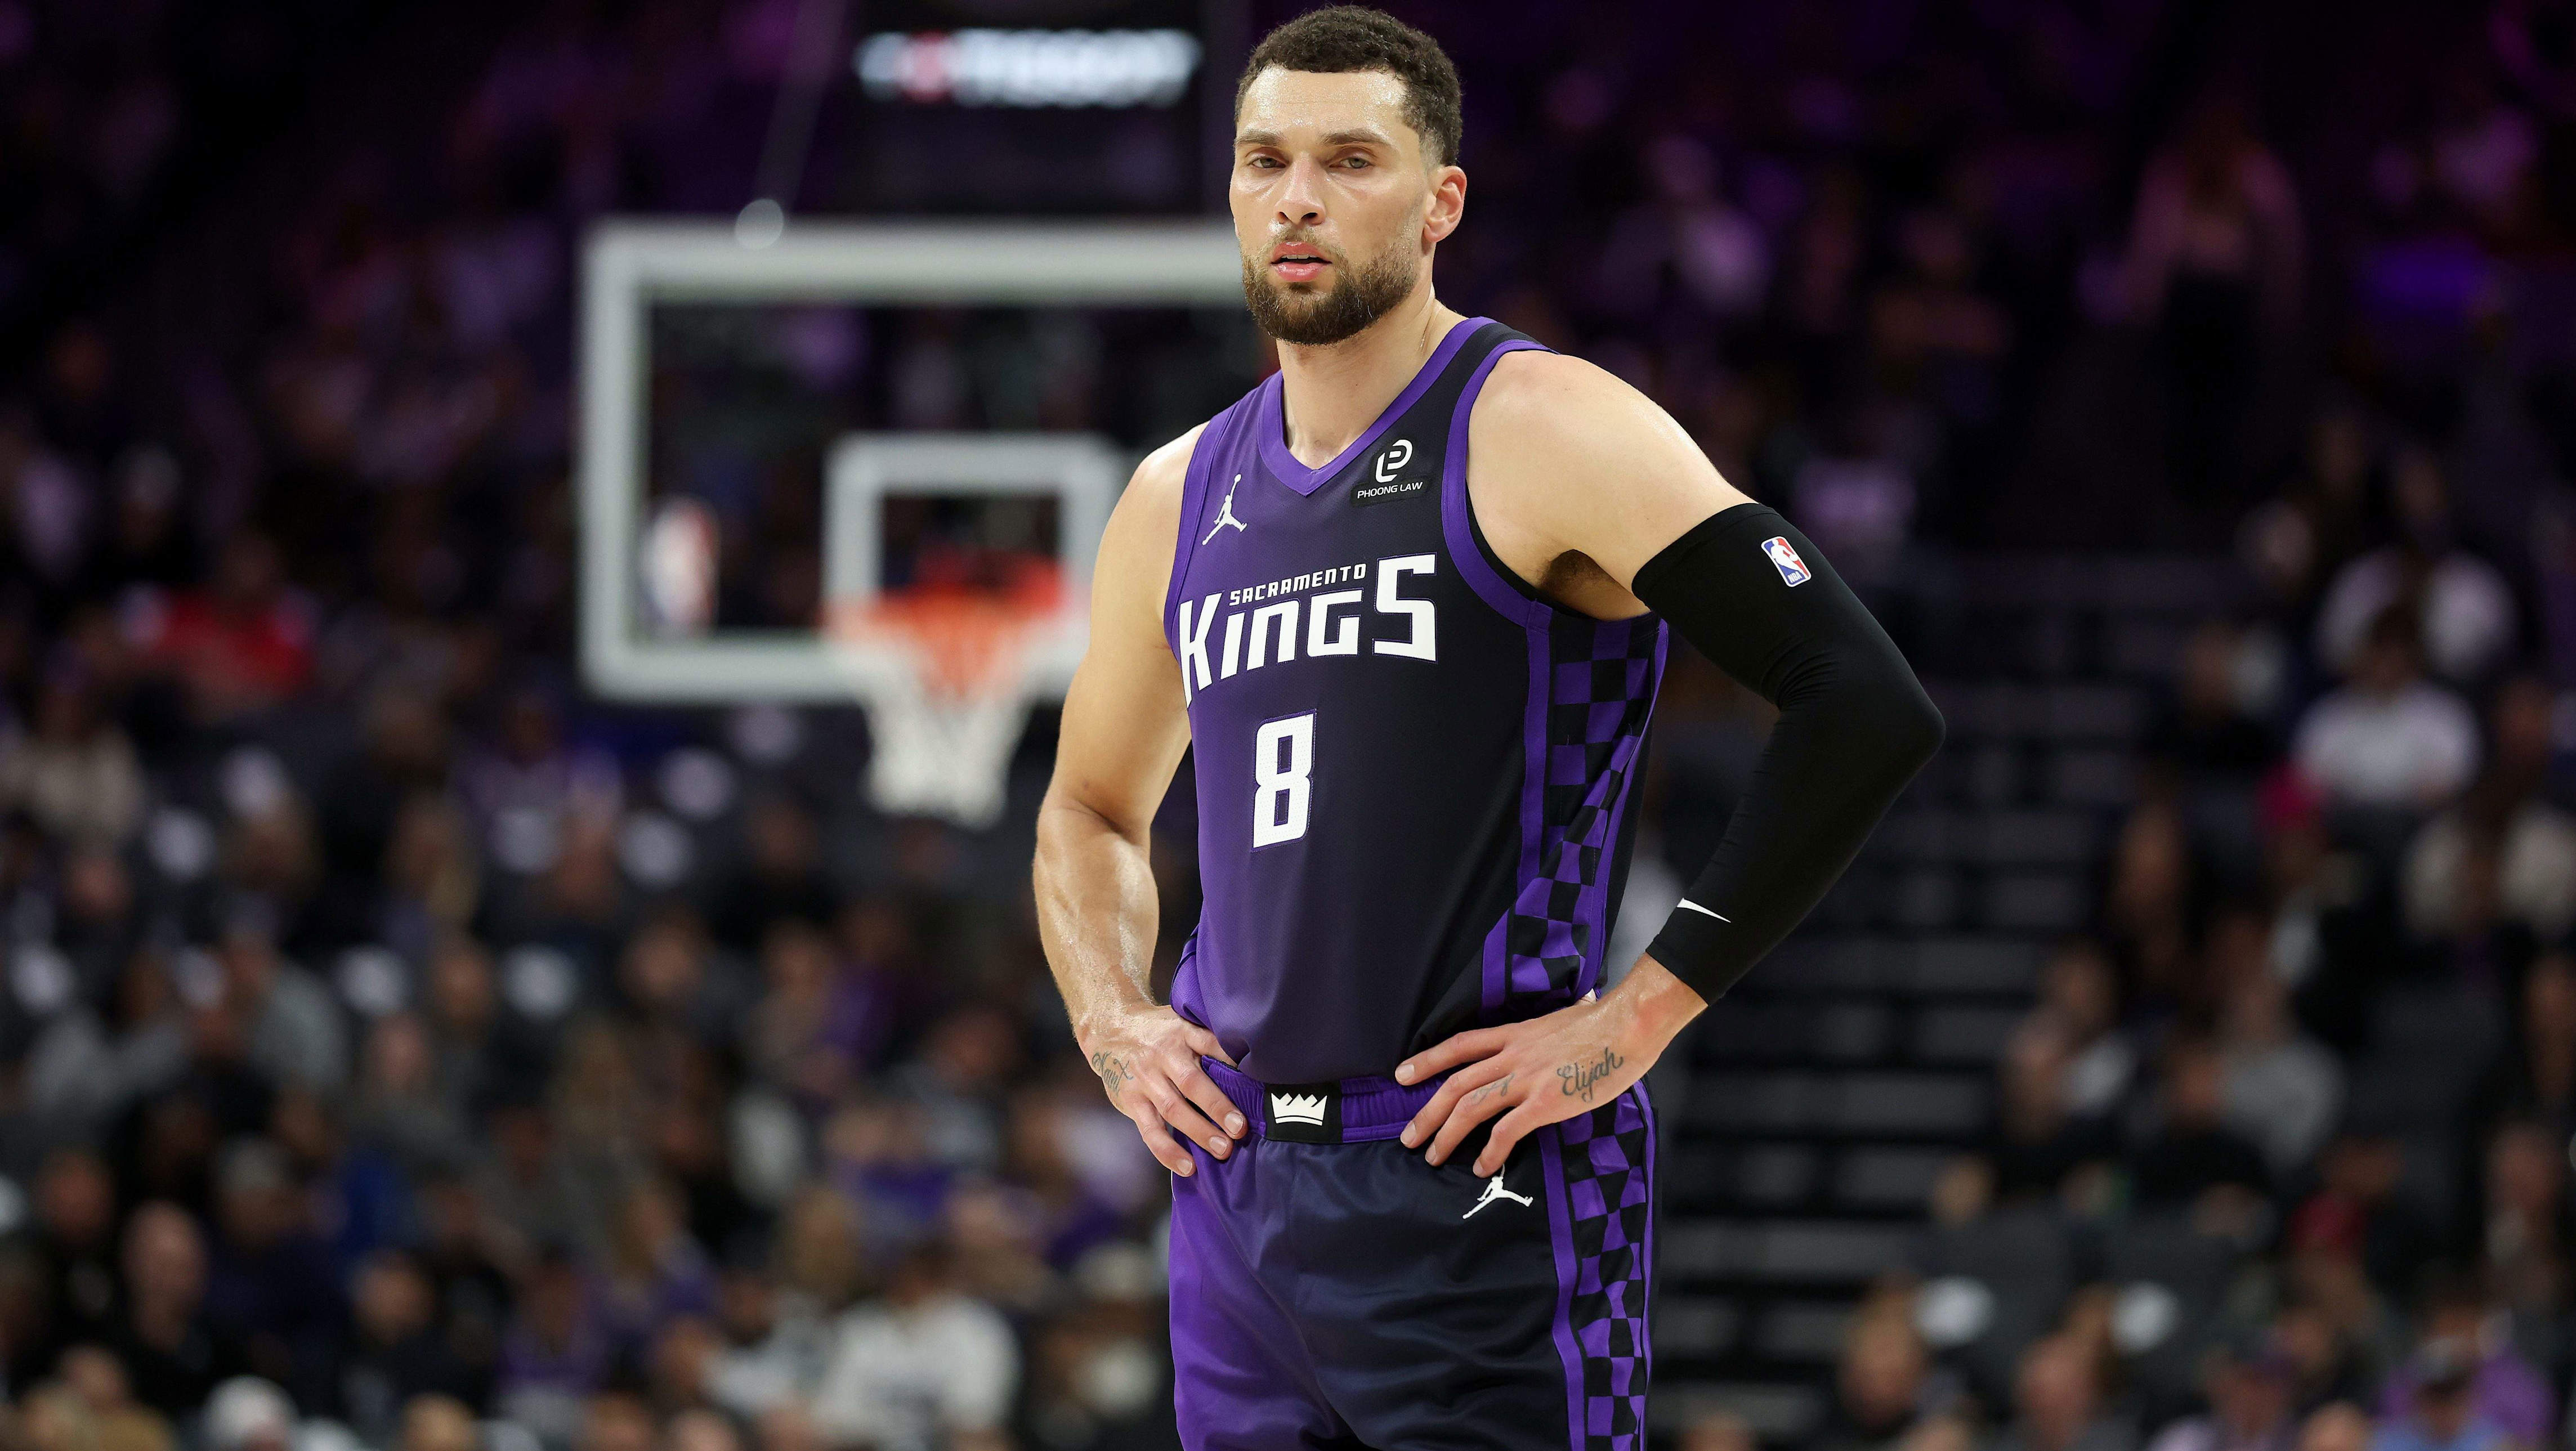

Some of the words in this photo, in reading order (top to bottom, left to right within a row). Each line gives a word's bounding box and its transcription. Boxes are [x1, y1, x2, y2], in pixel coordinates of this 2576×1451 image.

[1357, 485, 1398, 499] PHOONG
[1399, 482, 1423, 491] LAW
[1229, 563, 1366, 606] SACRAMENTO
[1787, 571, 1803, 583] NBA
[1251, 710, 1316, 851] 8
[1557, 1046, 1624, 1103] Elijah
